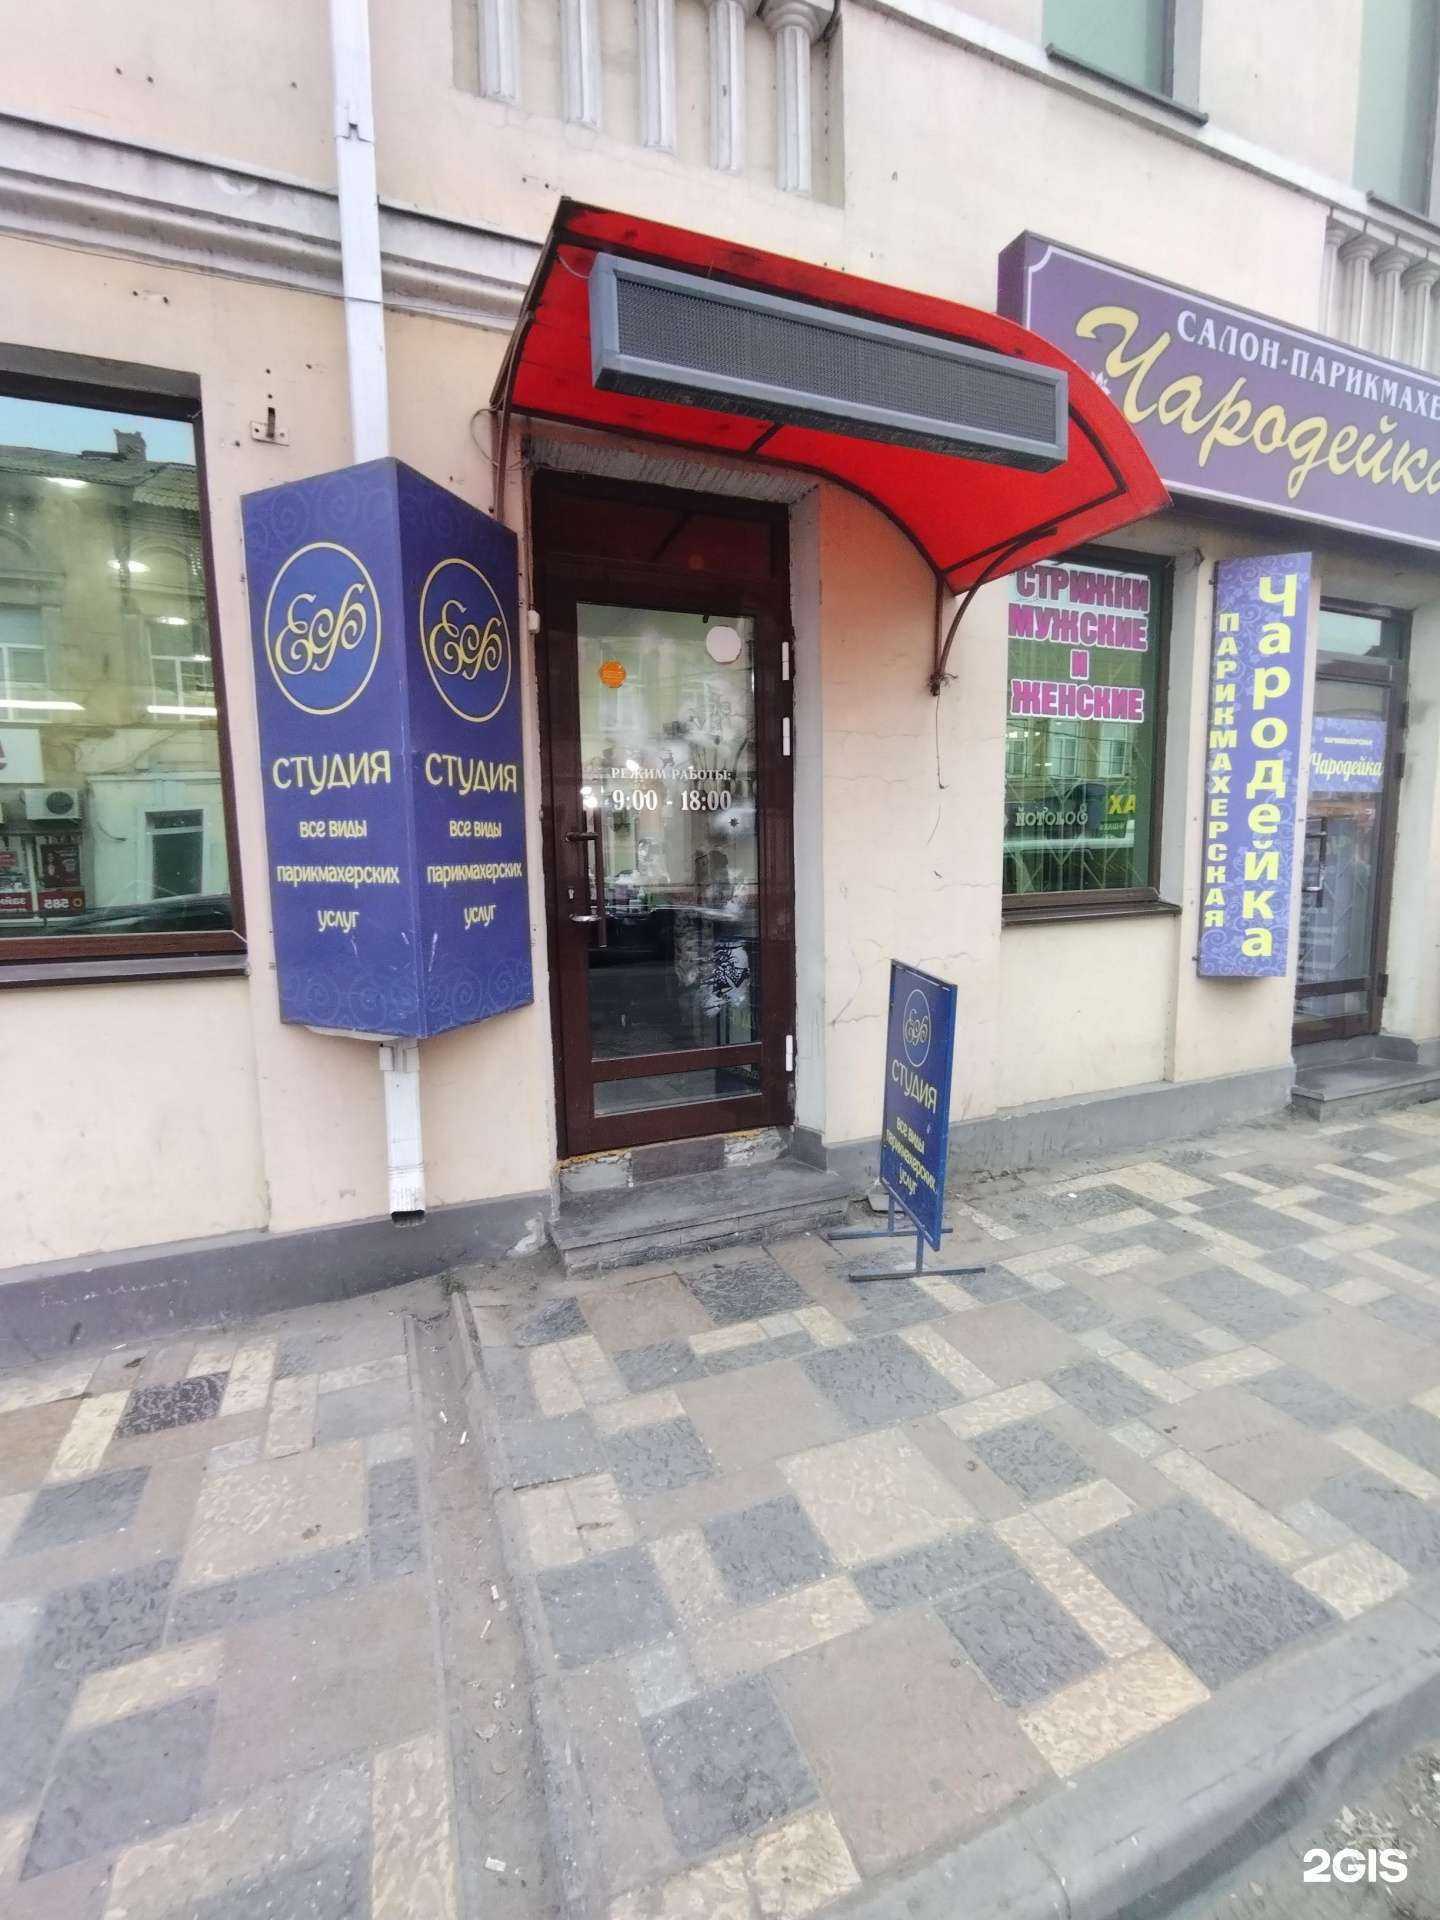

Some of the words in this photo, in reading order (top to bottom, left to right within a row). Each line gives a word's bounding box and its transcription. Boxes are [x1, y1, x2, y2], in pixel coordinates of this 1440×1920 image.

[1016, 564, 1149, 613] СТРИЖКИ
[1008, 602, 1148, 652] МУЖСКИЕ
[1070, 649, 1089, 679] И
[1010, 679, 1144, 723] ЖЕНСКИЕ
[611, 767, 666, 779] РЕЖИМ
[672, 768, 732, 781] РАБОТЫ:
[1204, 612, 1240, 928] ПАРИКМАХЕРСКАЯ
[1241, 573, 1298, 958] Чародейка
[1311, 752, 1384, 782] Чародейка
[612, 789, 658, 811] 9:00
[680, 789, 731, 811] 18:00
[299, 820, 326, 838] все
[329, 820, 367, 838] виды
[449, 820, 472, 837] все
[474, 820, 502, 838] виды
[277, 865, 400, 888] парикмахерских
[427, 862, 522, 888] парикмахерских
[318, 910, 360, 933] услуг
[464, 904, 496, 930] услуг
[908, 1127, 925, 1155] виды
[886, 1128, 937, 1192] парикмахерских
[899, 1166, 917, 1196] услуг
